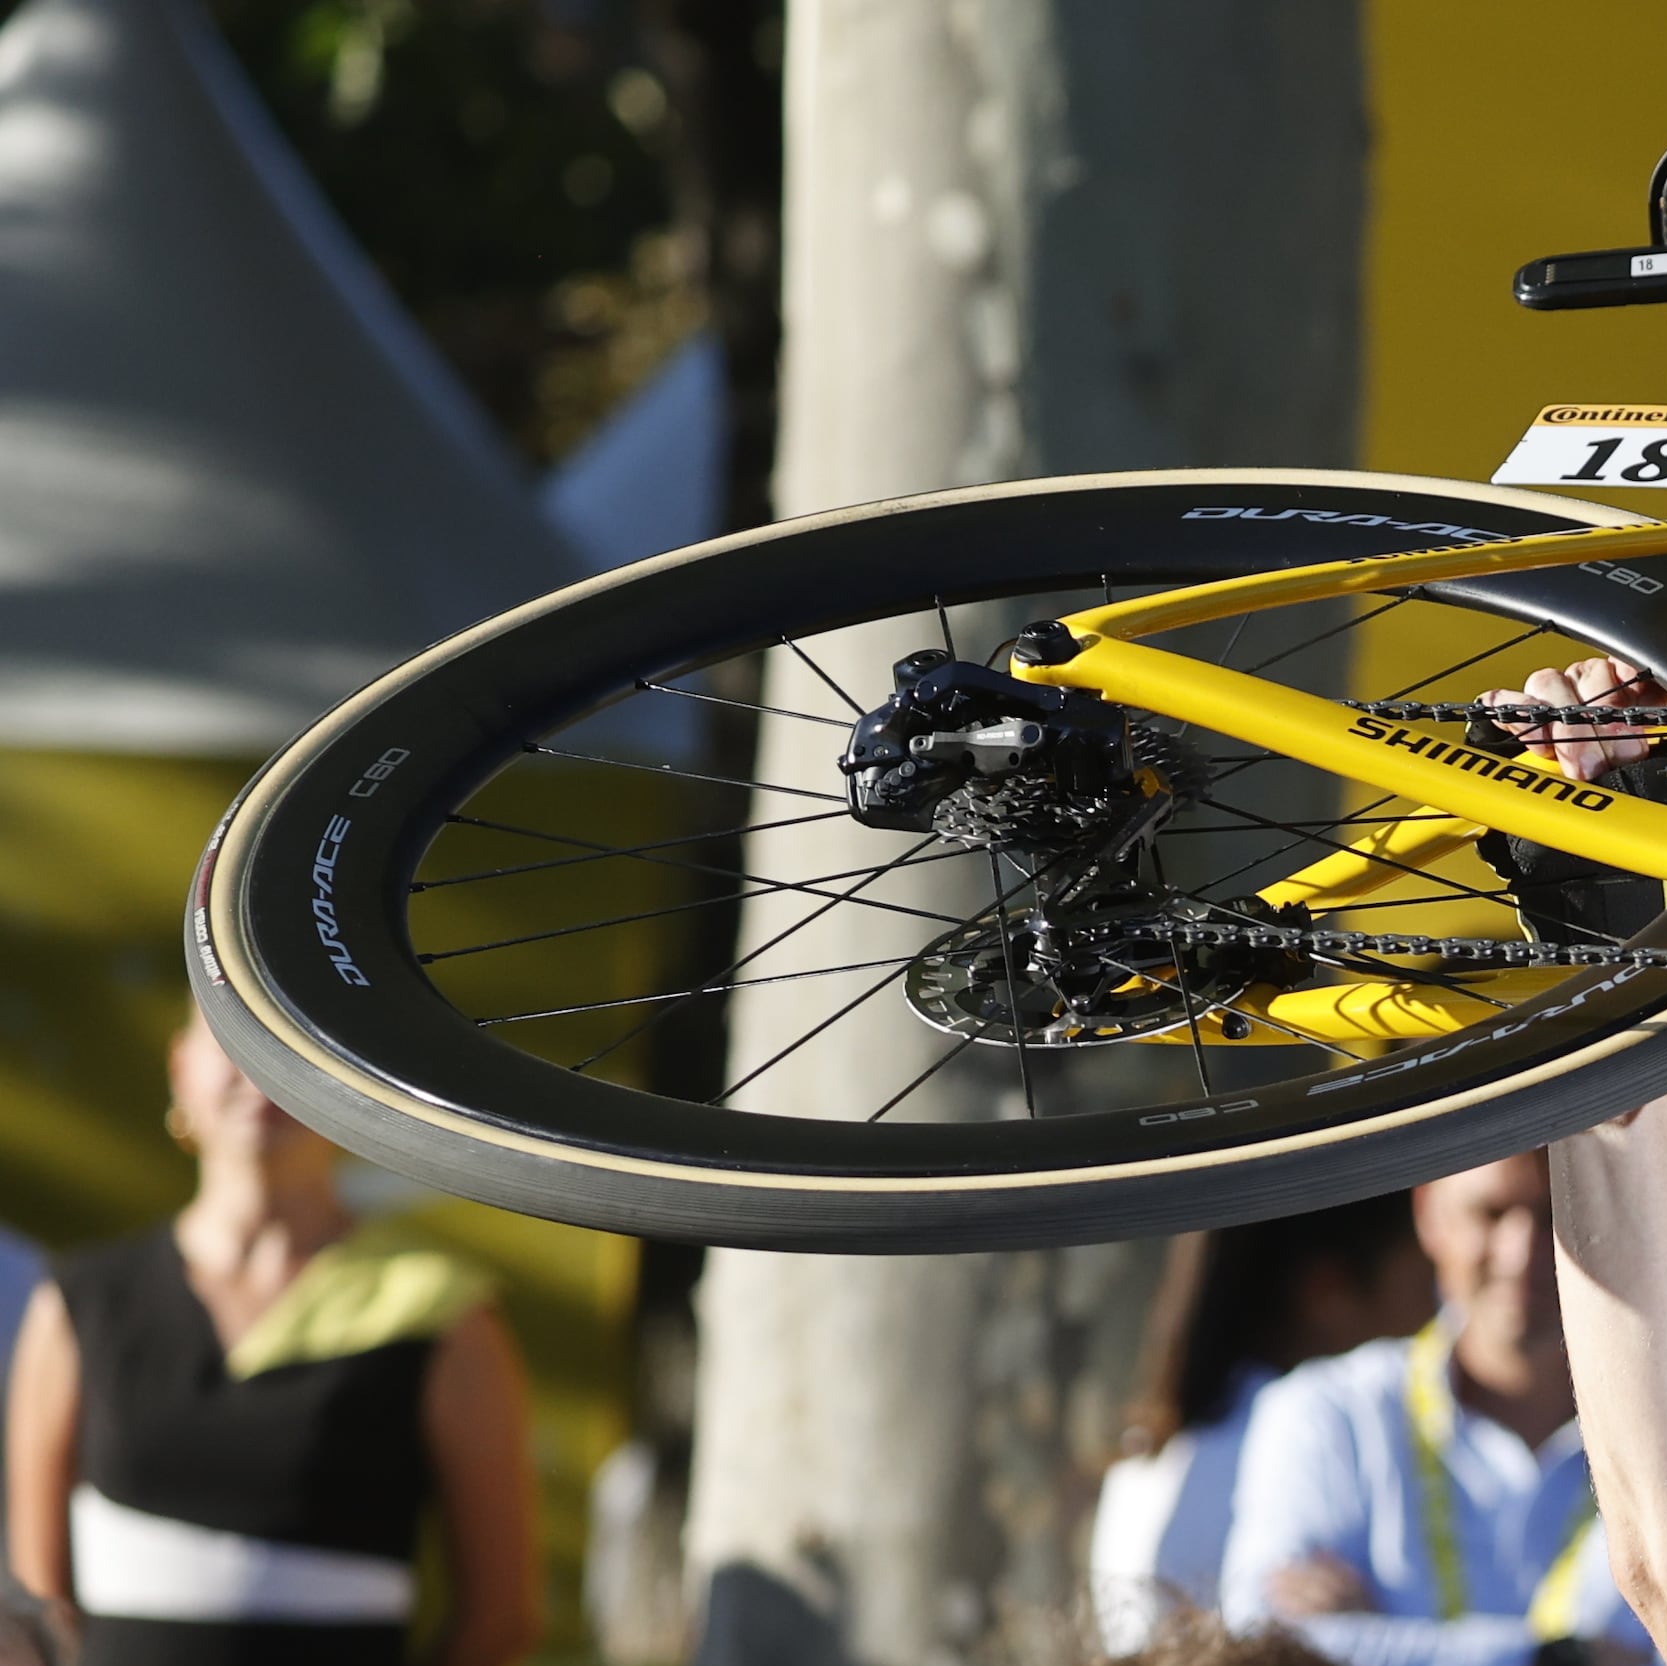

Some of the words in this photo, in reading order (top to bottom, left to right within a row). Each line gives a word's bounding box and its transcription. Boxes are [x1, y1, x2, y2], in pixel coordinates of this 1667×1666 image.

[1181, 506, 1510, 545] DURA-AC
[348, 747, 412, 797] C60
[1348, 716, 1615, 812] SHIMANO
[311, 814, 371, 987] DURA-ACE
